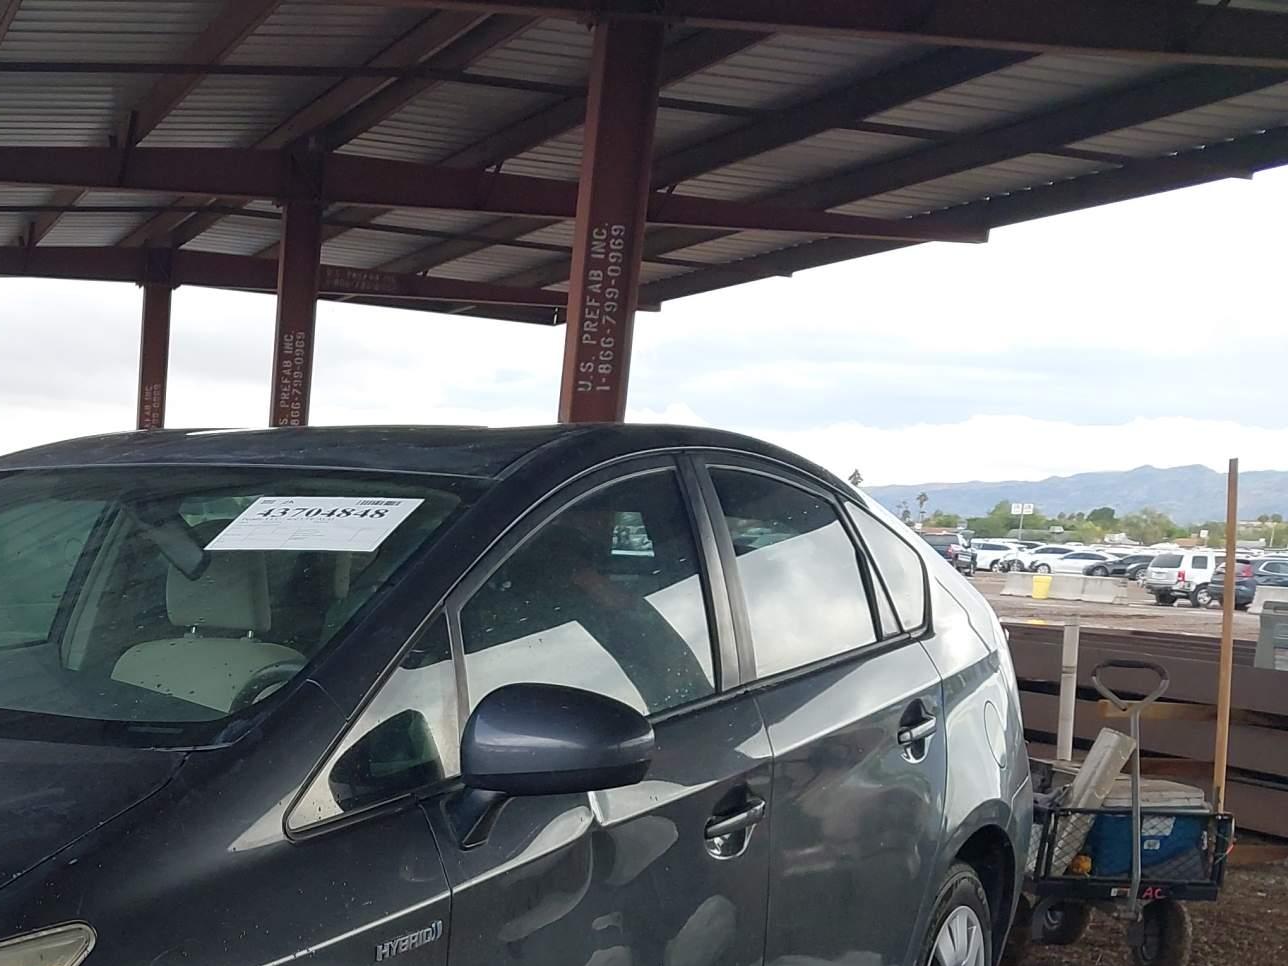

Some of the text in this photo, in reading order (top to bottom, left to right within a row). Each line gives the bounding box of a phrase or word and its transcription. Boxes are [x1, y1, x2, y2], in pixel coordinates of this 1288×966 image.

[577, 222, 610, 392] U.S. PREFAB INC.
[596, 224, 626, 391] 1-866-799-0969
[280, 360, 293, 408] PREFAB
[256, 506, 390, 520] 43704848
[1142, 887, 1166, 899] AC
[376, 927, 434, 962] HYBRID
